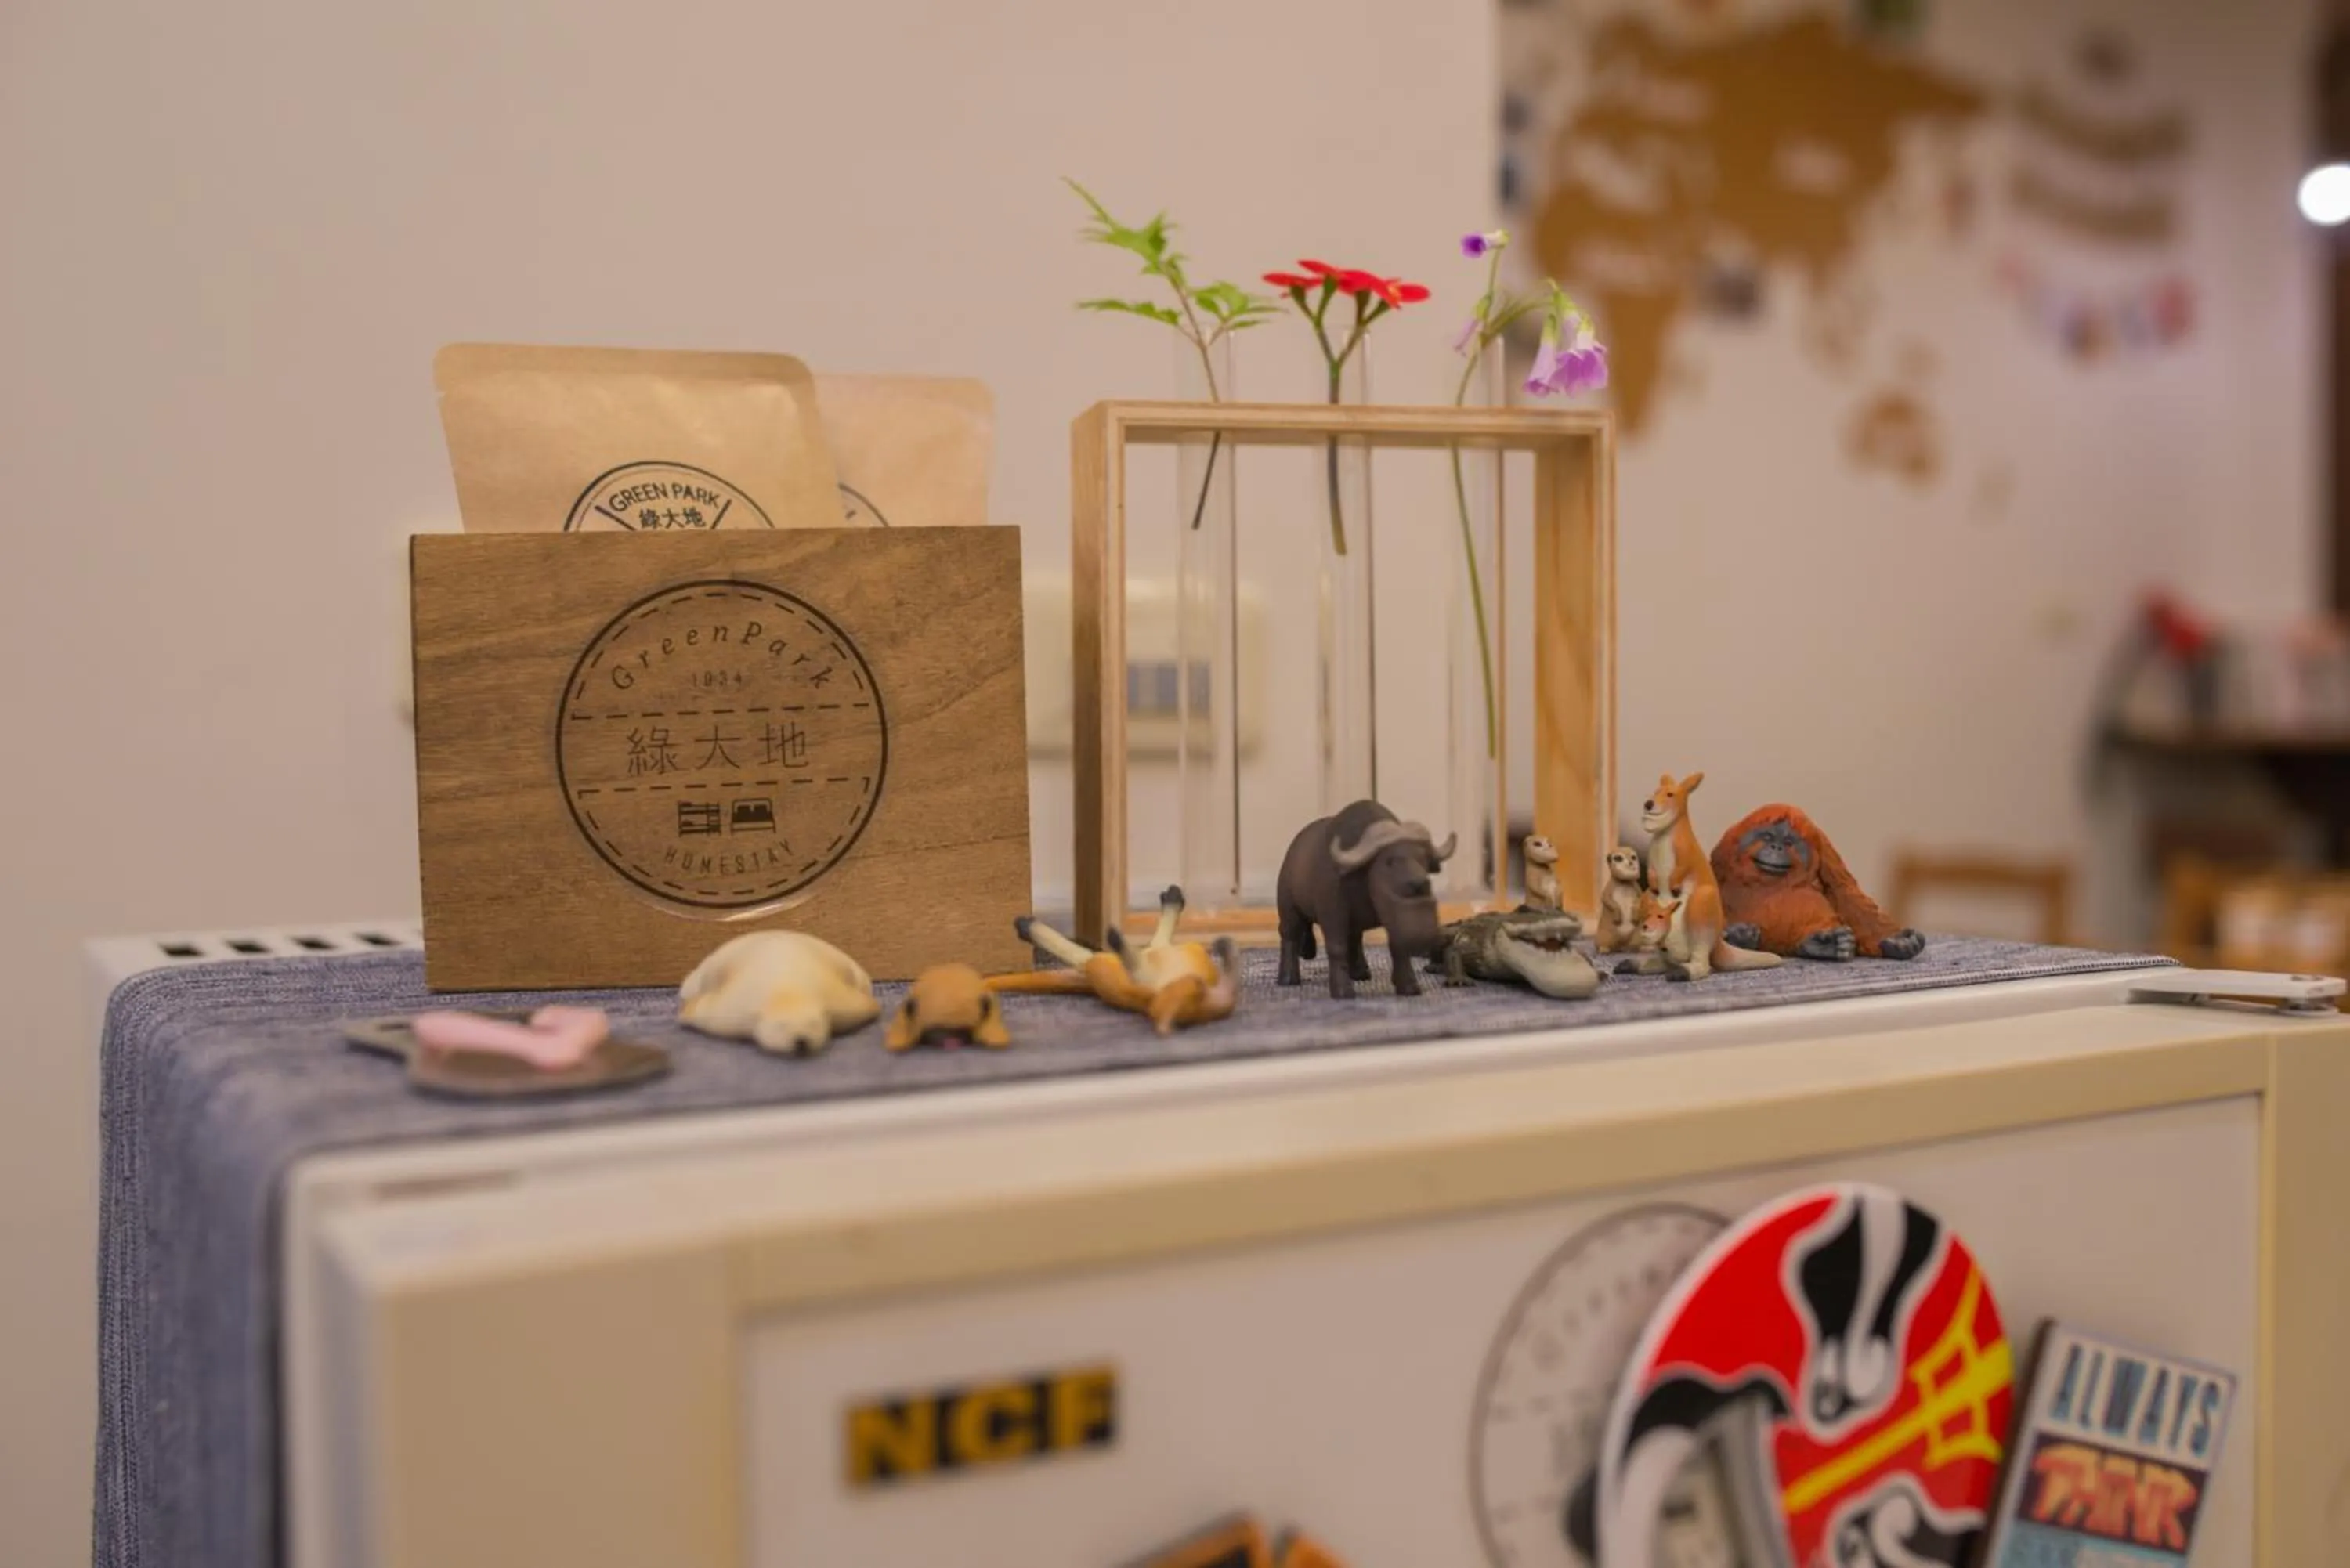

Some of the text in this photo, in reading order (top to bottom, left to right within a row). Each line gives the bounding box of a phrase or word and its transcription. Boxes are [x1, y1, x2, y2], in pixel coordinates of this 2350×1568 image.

[609, 482, 720, 511] GREEN PARK
[638, 507, 707, 529] 綠大地
[627, 721, 810, 776] 綠大地
[664, 838, 794, 876] HOMESTAY
[2048, 1342, 2220, 1459] ALWAYS
